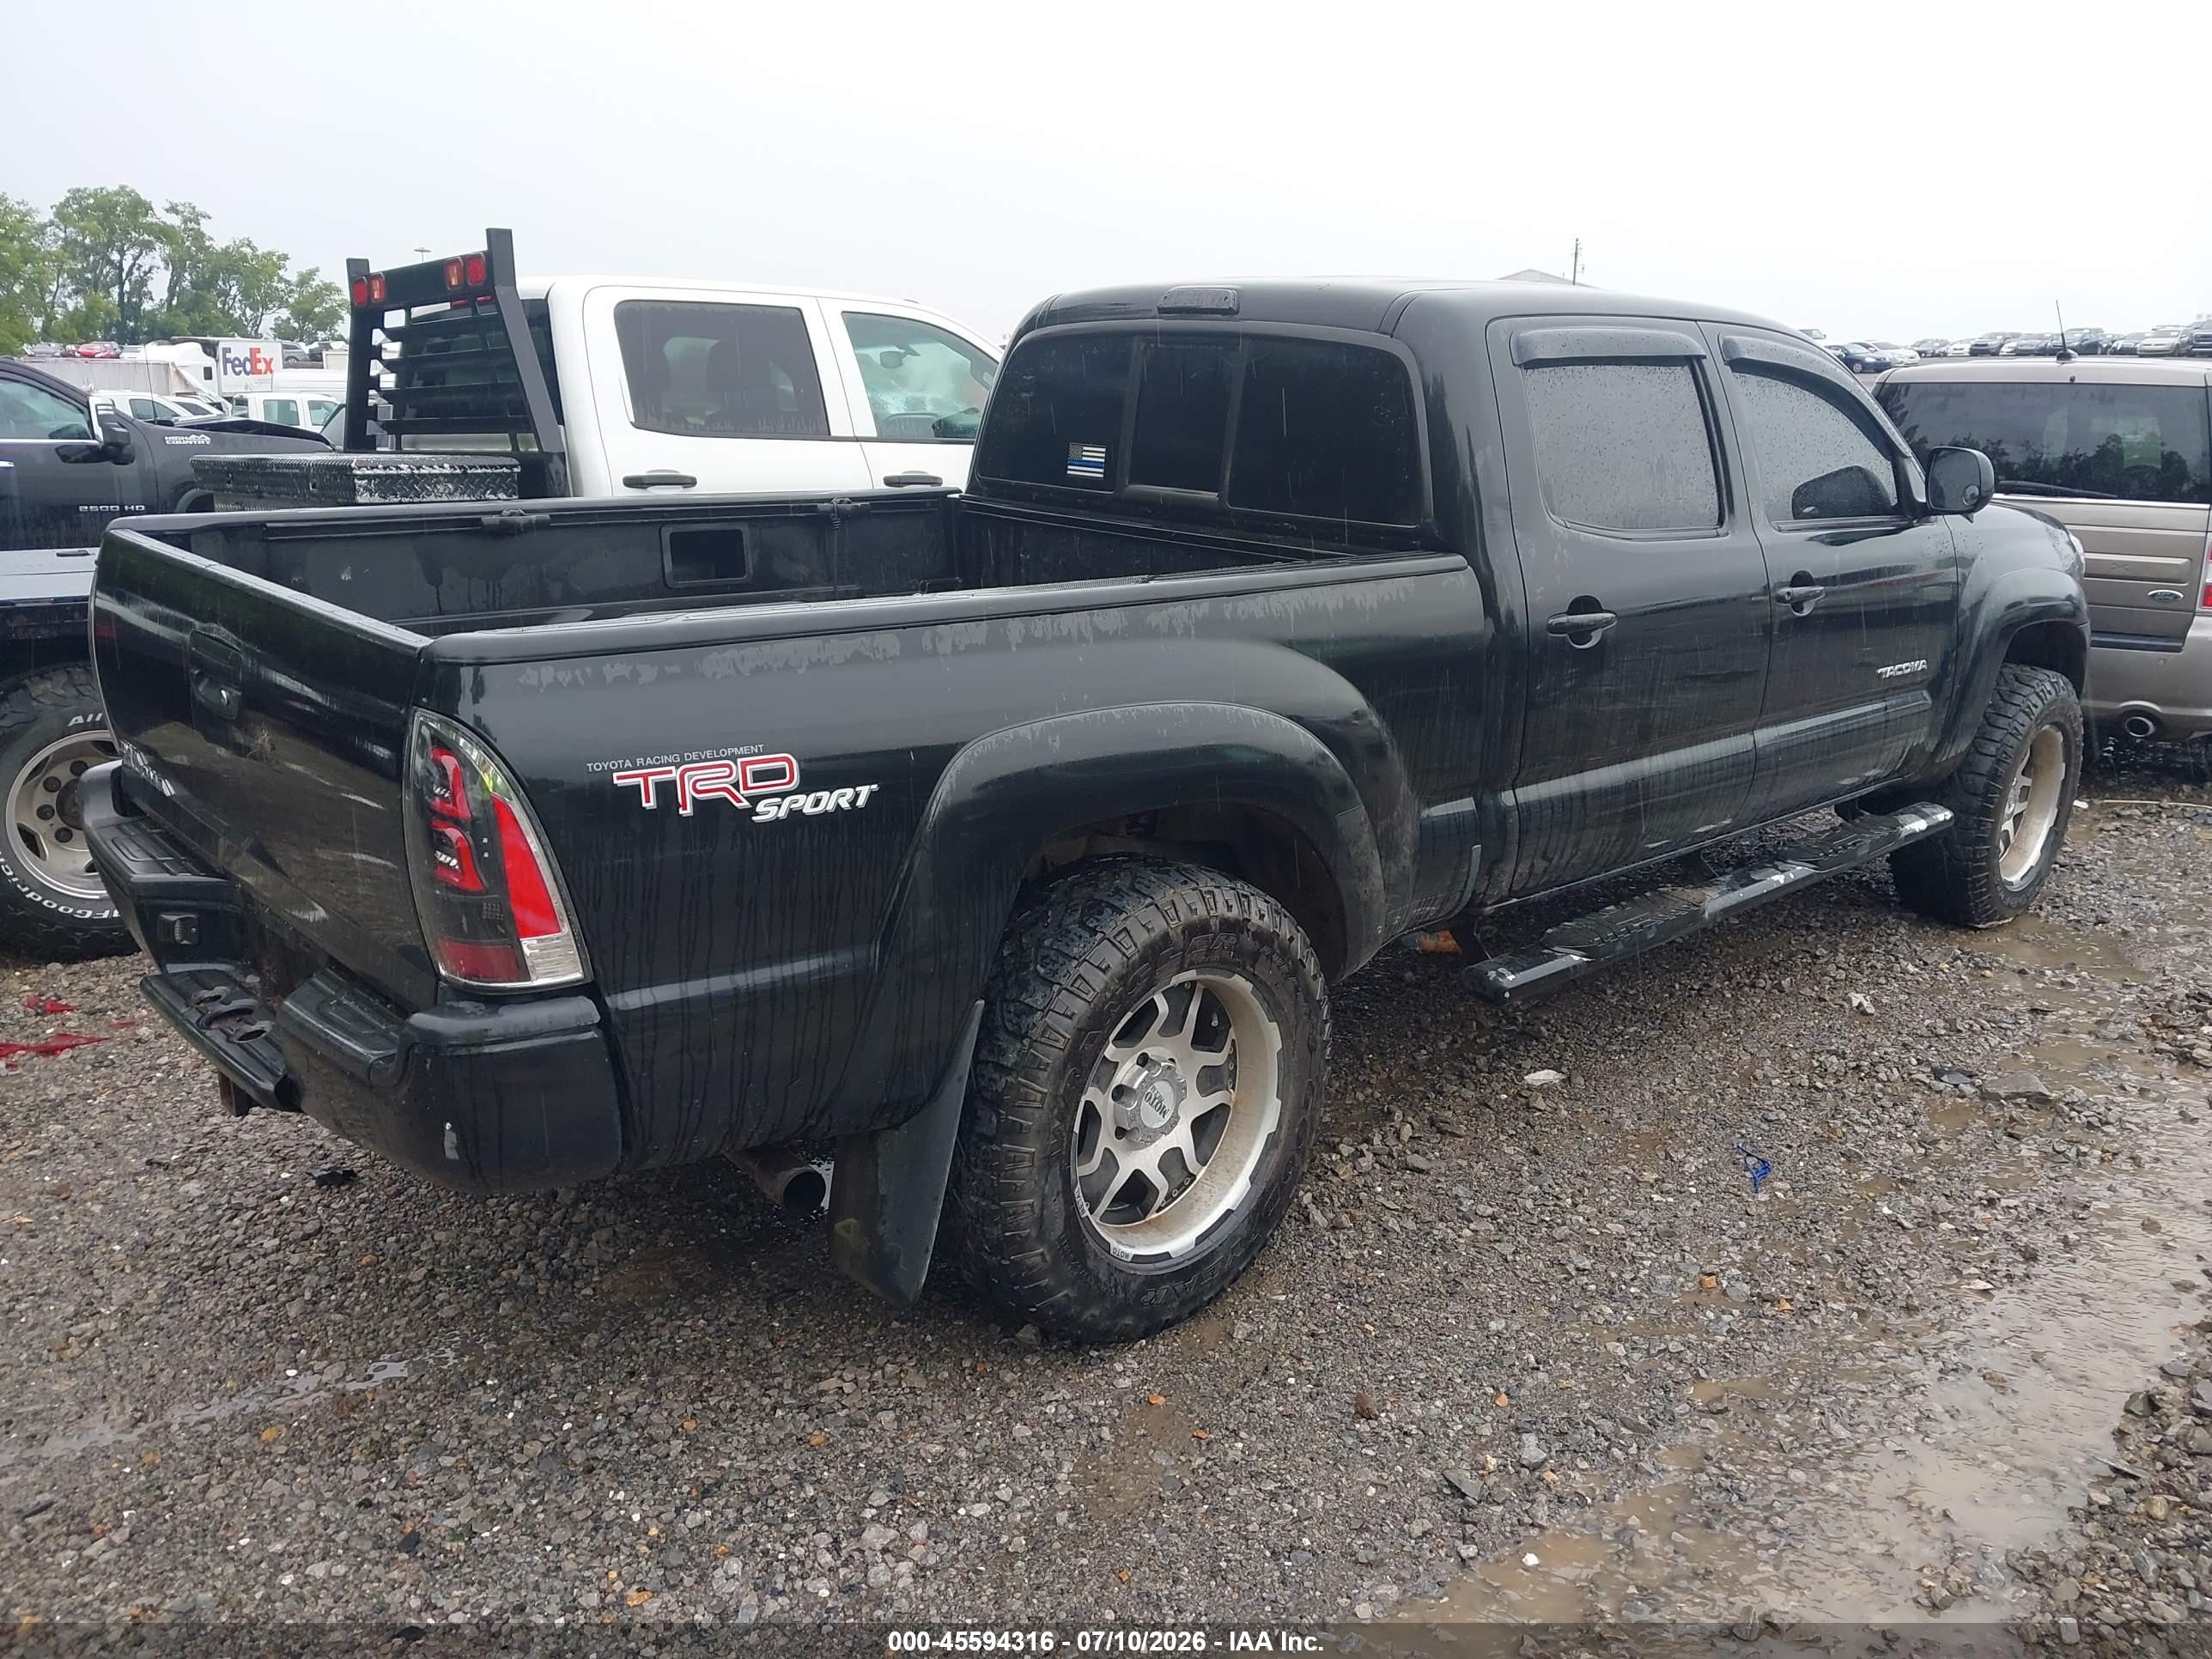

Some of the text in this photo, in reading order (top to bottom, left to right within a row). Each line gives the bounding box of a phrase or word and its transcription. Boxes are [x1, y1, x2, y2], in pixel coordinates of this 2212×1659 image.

[222, 347, 274, 376] FedEx
[1875, 659, 1928, 679] TACOMA
[586, 744, 765, 773] TOYOTA RACING DEVELOPMENT
[612, 753, 800, 817] TRD
[751, 784, 880, 823] SPORT
[1144, 1091, 1170, 1120] MOTO
[1112, 1247, 1131, 1260] MOTO
